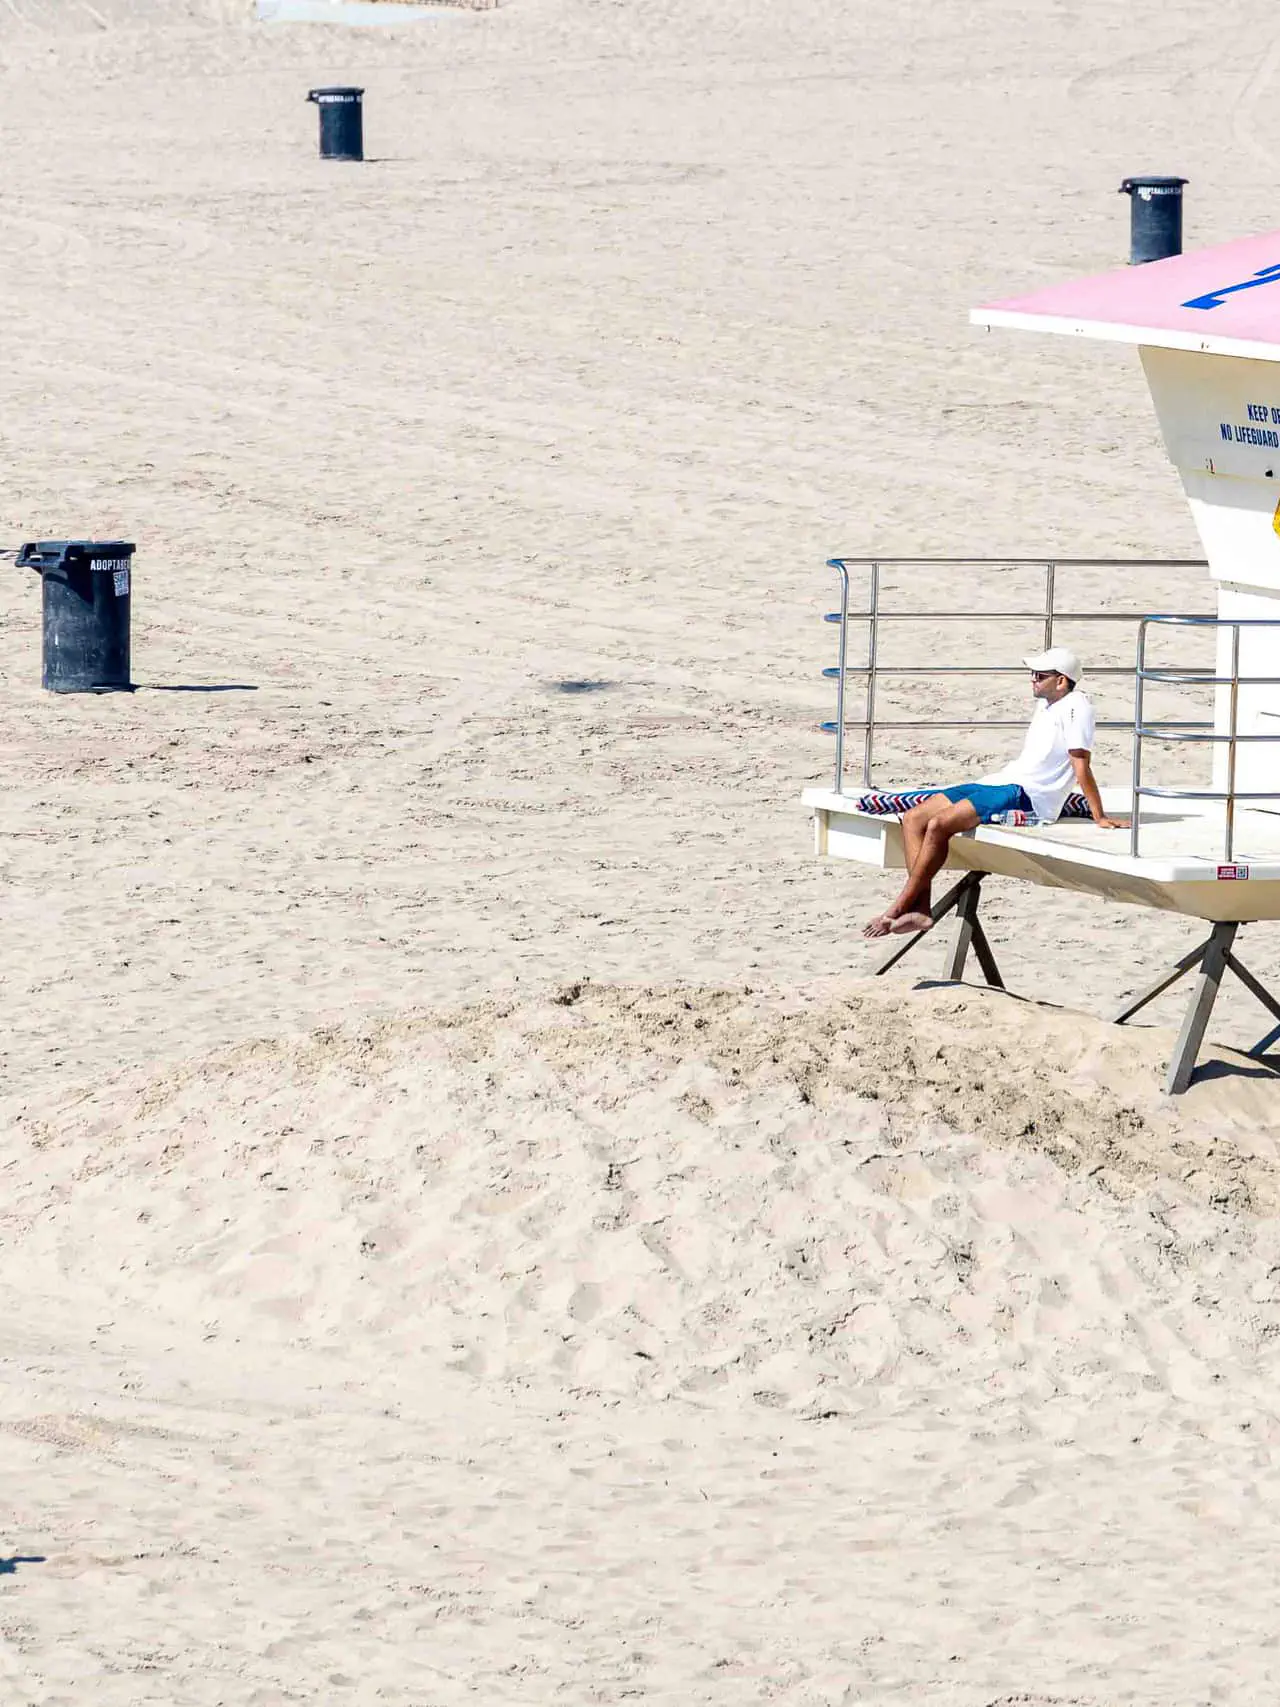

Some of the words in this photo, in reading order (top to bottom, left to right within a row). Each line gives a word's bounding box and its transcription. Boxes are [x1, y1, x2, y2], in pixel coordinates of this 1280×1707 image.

[1247, 404, 1268, 422] KEEP
[1220, 423, 1232, 441] NO
[1234, 425, 1279, 448] LIFEGUARD
